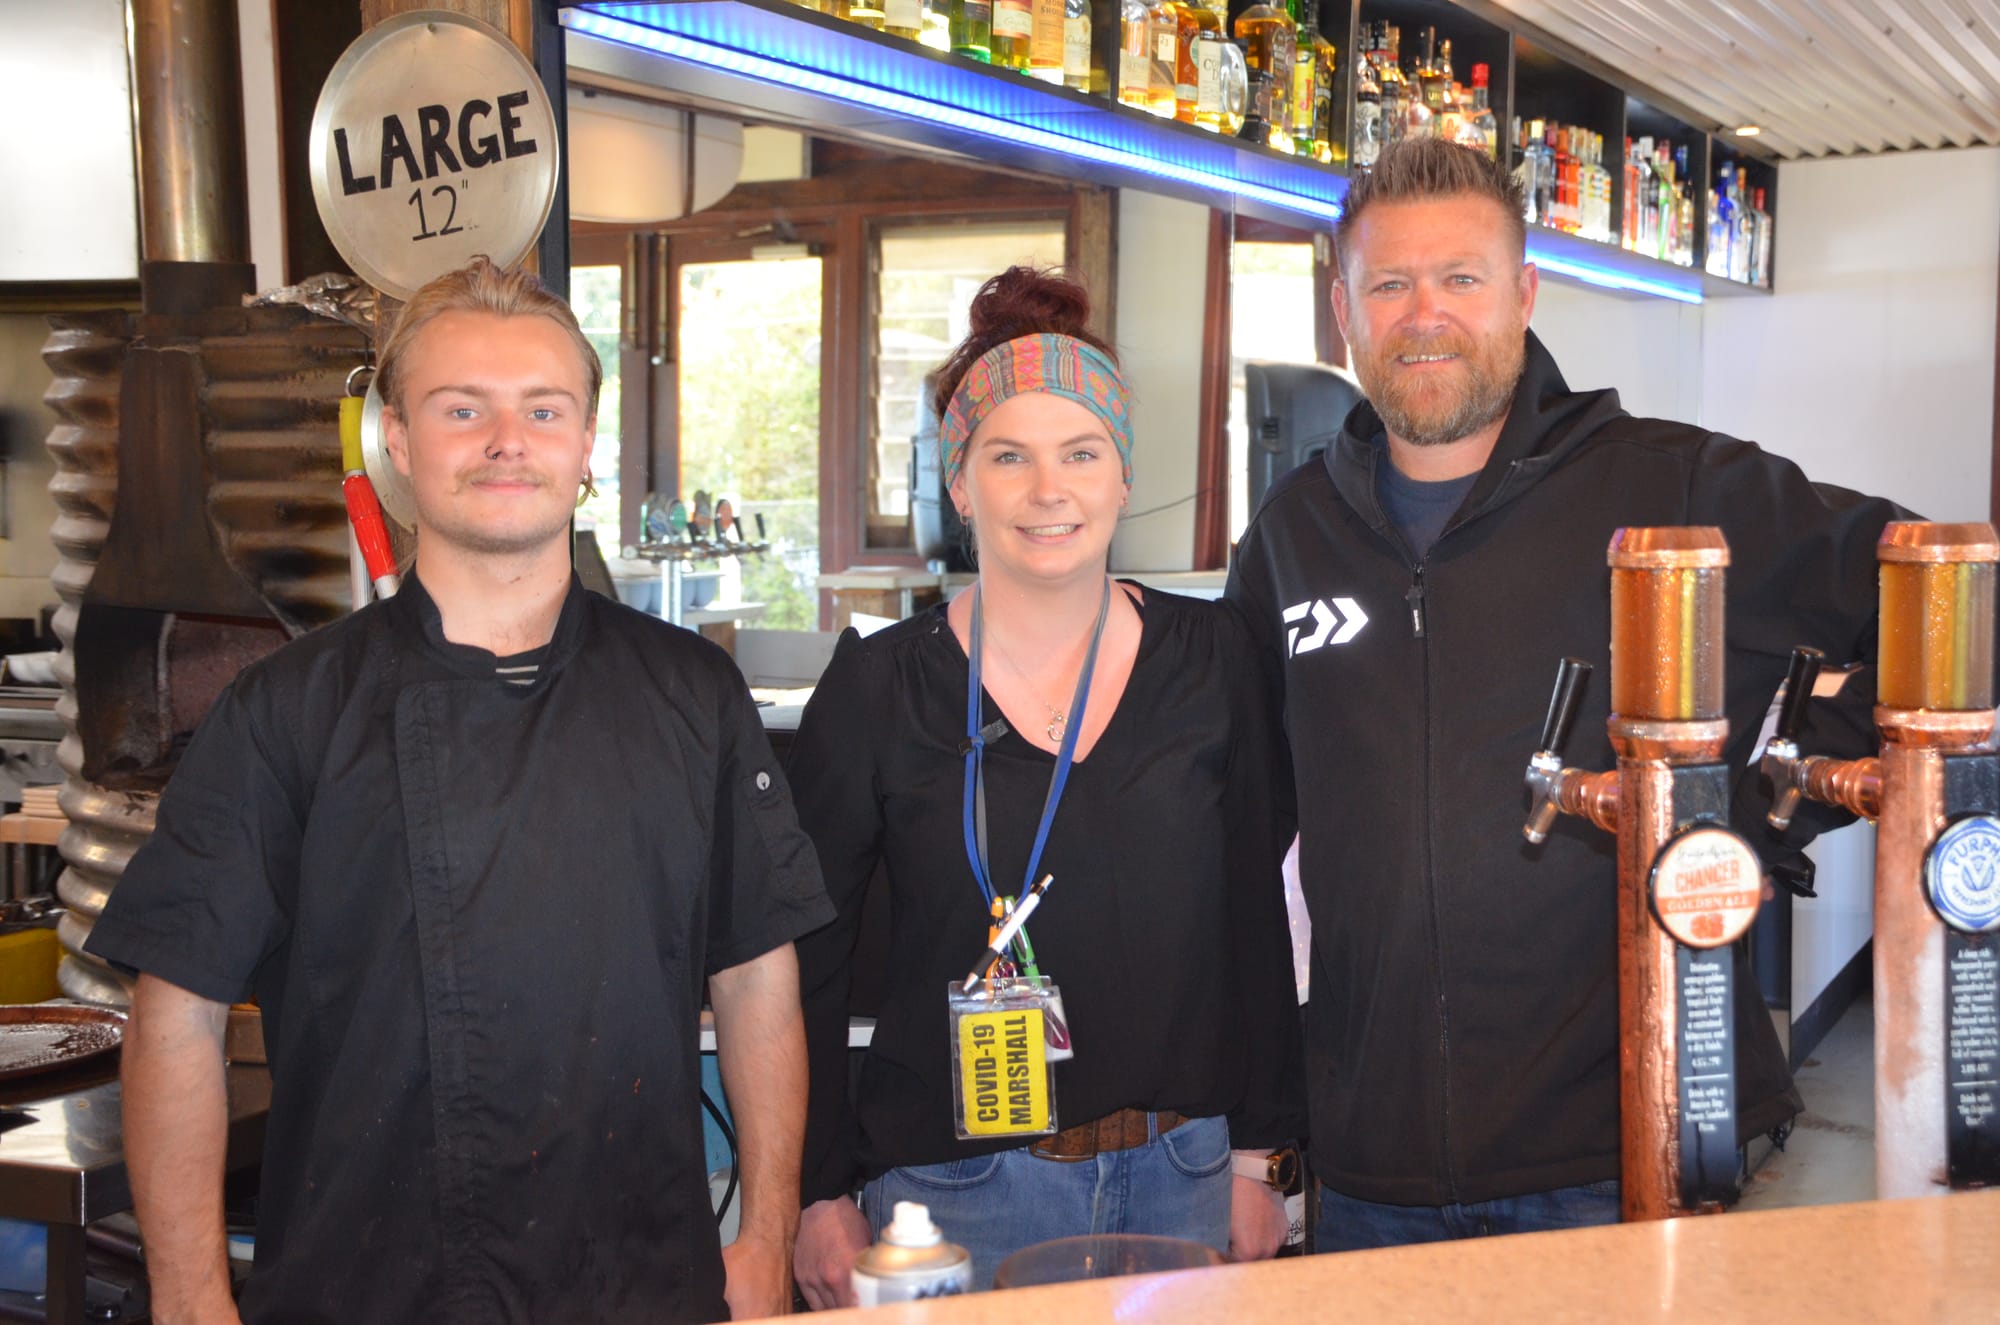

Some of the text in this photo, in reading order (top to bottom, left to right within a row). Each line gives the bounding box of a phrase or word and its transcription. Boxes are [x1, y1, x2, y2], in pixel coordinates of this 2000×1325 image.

[333, 90, 538, 196] LARGE
[408, 179, 469, 241] 12"
[1675, 859, 1740, 893] CHANCER
[1949, 837, 2000, 867] FURPH
[972, 1024, 1000, 1122] COVID-19
[1005, 1015, 1032, 1125] MARSHALL
